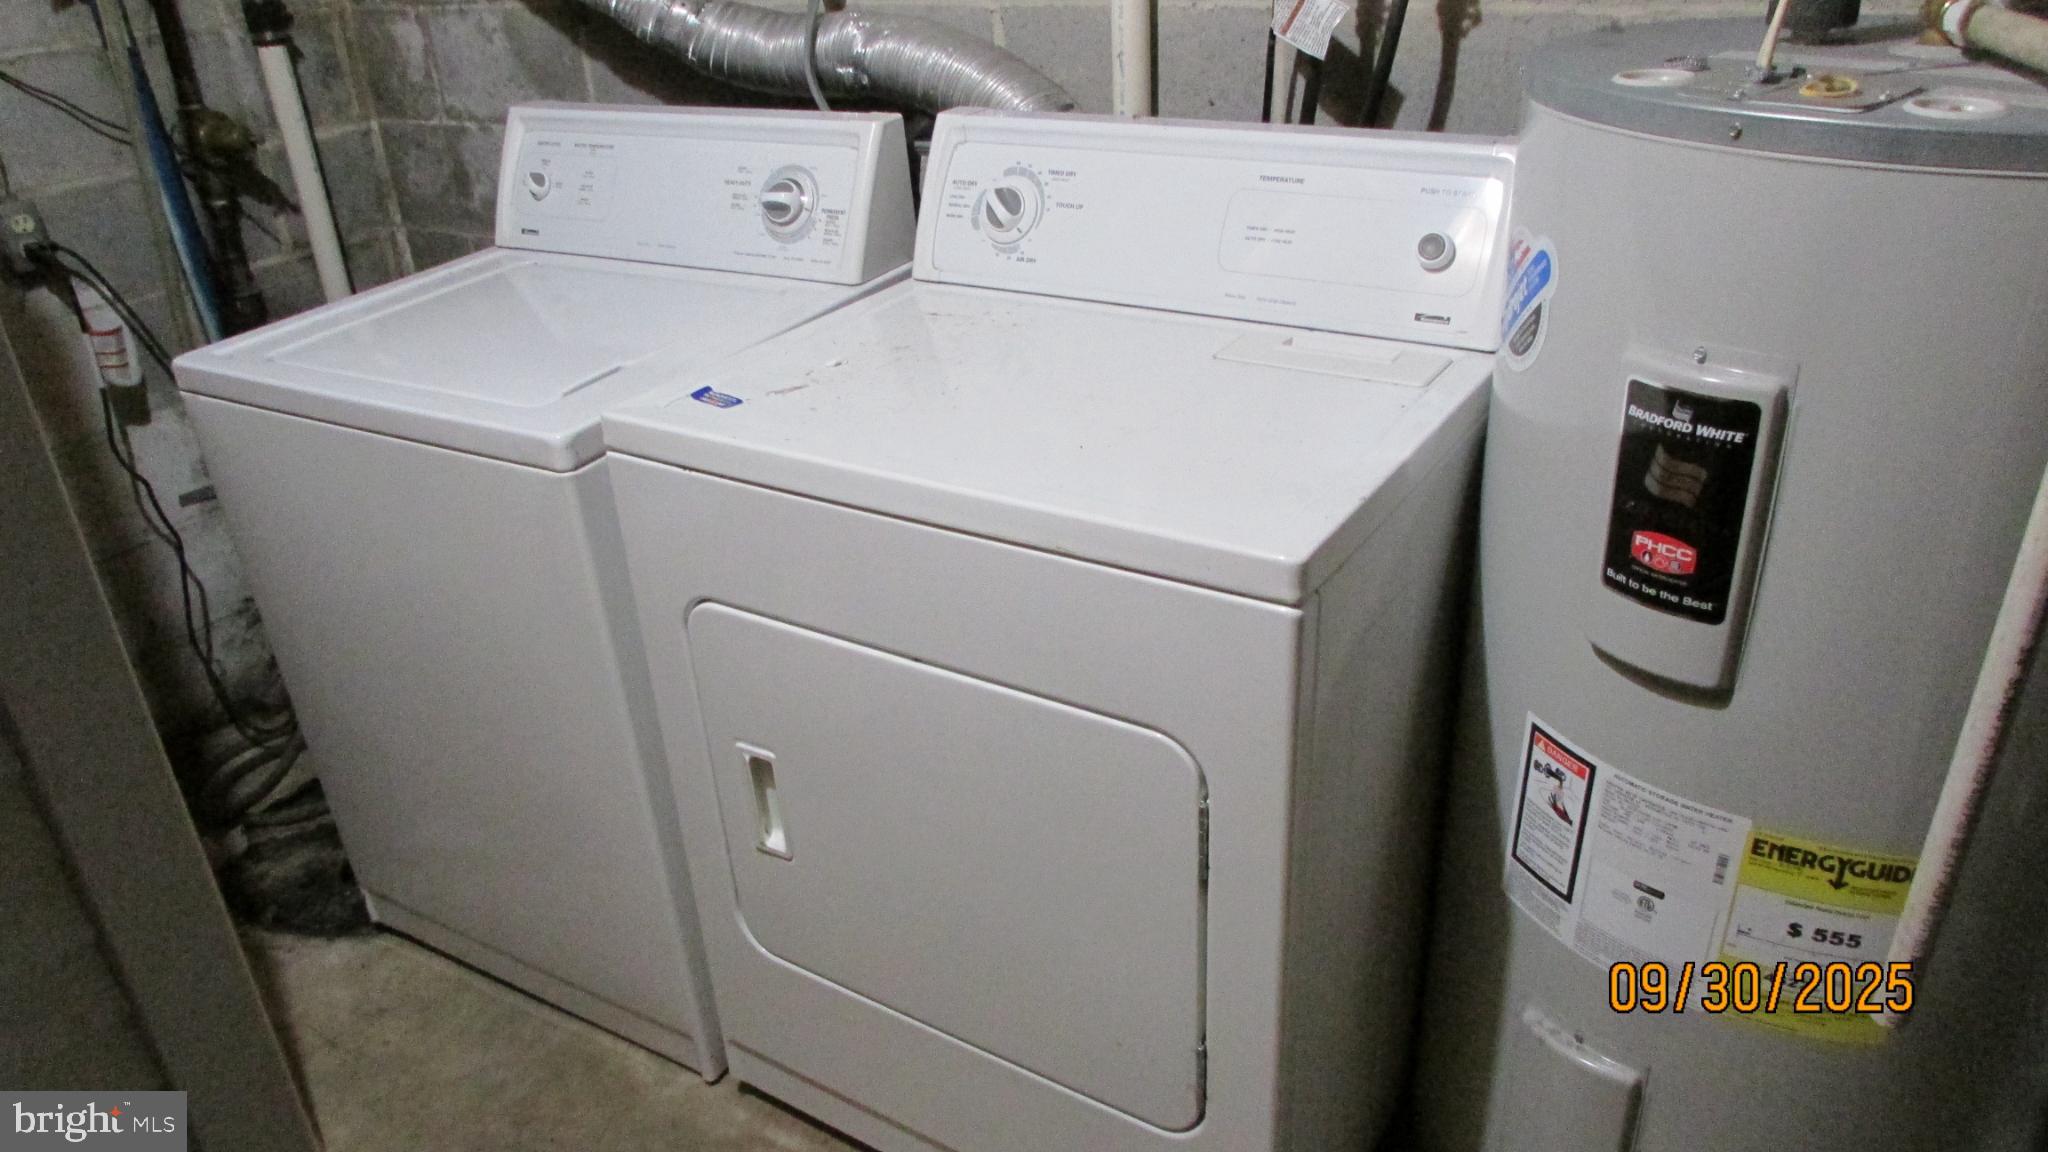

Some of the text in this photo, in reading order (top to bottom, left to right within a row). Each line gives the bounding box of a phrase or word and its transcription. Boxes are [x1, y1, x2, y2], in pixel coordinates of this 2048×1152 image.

[1259, 175, 1305, 185] TEMPERATURE
[1627, 404, 1746, 444] BRADFORD WHITE
[1635, 534, 1693, 562] PHCC
[1606, 567, 1627, 585] Built
[1629, 577, 1641, 590] to
[1641, 582, 1657, 597] be
[1660, 588, 1679, 603] the
[1683, 595, 1713, 611] Best
[1547, 743, 1579, 772] DANGER
[1751, 837, 1916, 885] ENERGYGUID
[1786, 922, 1862, 949] $ 555
